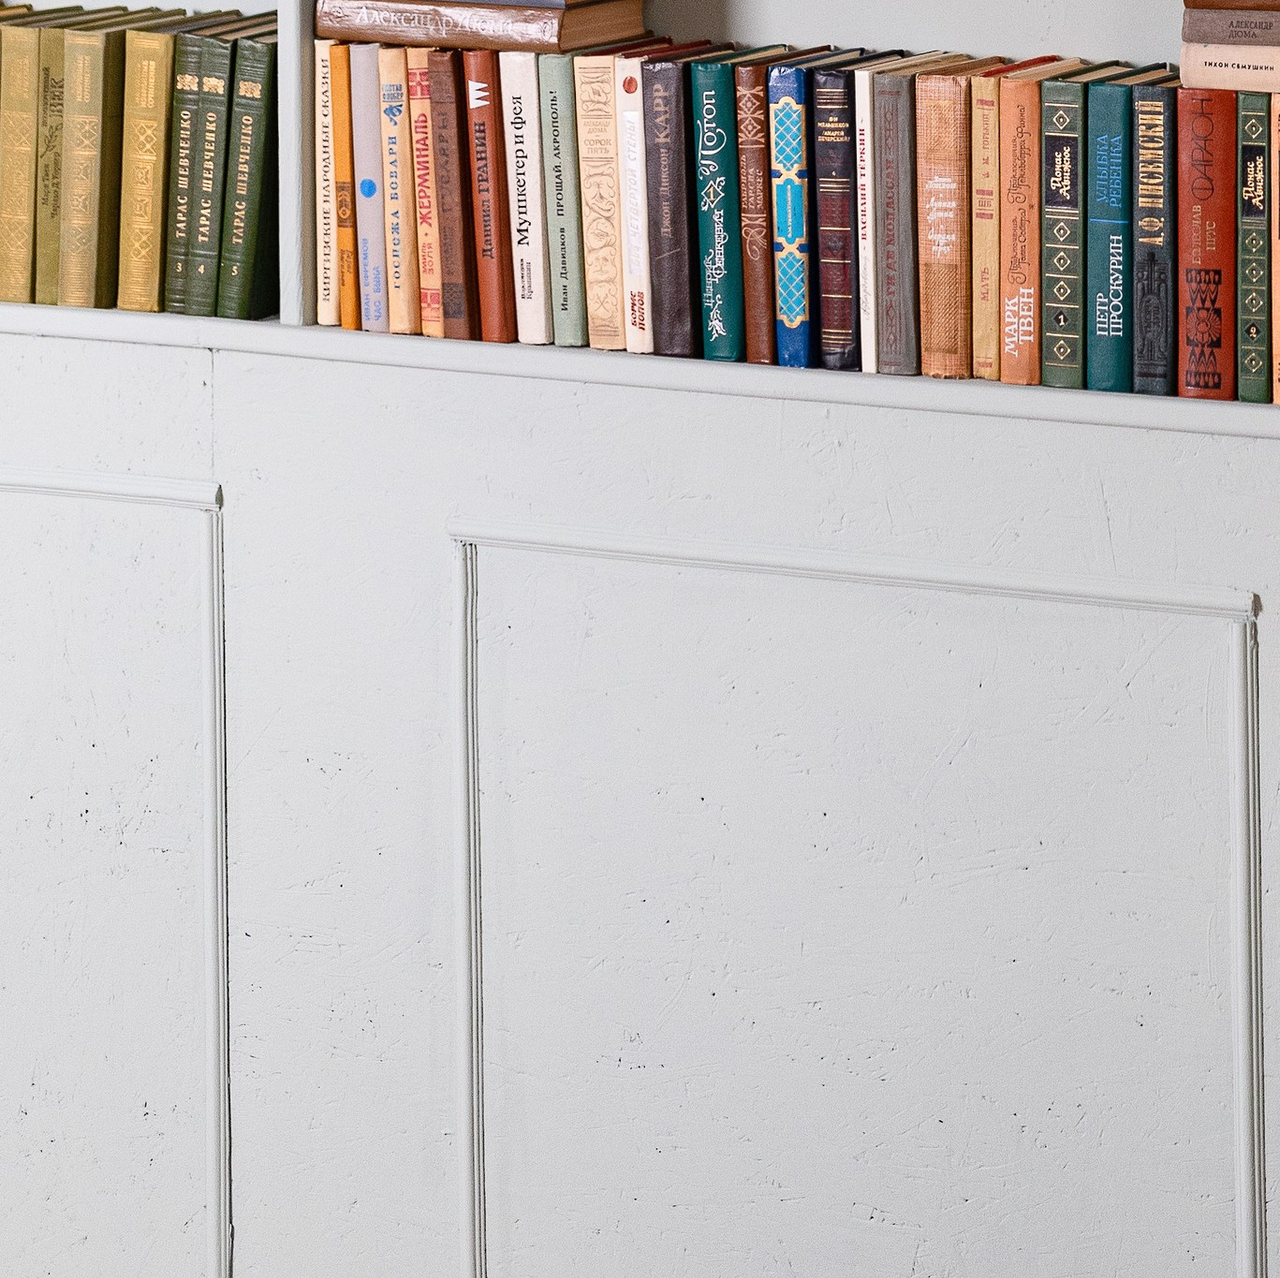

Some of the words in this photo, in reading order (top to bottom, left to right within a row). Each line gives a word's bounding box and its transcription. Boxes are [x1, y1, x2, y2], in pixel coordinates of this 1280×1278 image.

[321, 57, 330, 118] СКАЗКИ
[1204, 60, 1228, 68] ТИХОН
[1231, 63, 1275, 71] СЕМУШКИН
[510, 94, 527, 131] фея
[514, 133, 523, 146] и
[653, 82, 671, 144] КАРР
[177, 109, 191, 189] ШЕВЧЕНКО
[322, 121, 331, 204] НАРОДНЫЕ
[388, 135, 398, 201] БОВАРИ
[413, 112, 432, 228] ЖЕРМИНАЛЬ
[473, 120, 491, 195] ГРАНИН
[658, 148, 671, 197] Диксон
[1050, 150, 1063, 191] Йонас
[1060, 146, 1072, 200] Авижюс
[1096, 133, 1108, 204] УЛЫБКА
[1109, 134, 1123, 208] РЕБЕНКА
[1135, 99, 1164, 208] ПИСЕМСКИЙ
[1190, 96, 1214, 201] ФАРАОН
[175, 195, 188, 238] ТАРАС
[514, 148, 531, 247] Мушкетер
[661, 201, 673, 238] Джон
[321, 207, 331, 301] КИРГИЗСКИЕ
[390, 209, 401, 290] ГОСПОЖА
[481, 198, 495, 259] Даниил
[1205, 221, 1216, 251] ПРУС
[629, 290, 638, 327] БОРИС
[637, 290, 646, 331] ПОПОВ
[1019, 286, 1034, 344] ТВЕН
[1096, 292, 1108, 336] ПЕТР
[1109, 234, 1123, 337] ПРОСКУРИН
[1004, 296, 1019, 357] МАРК
